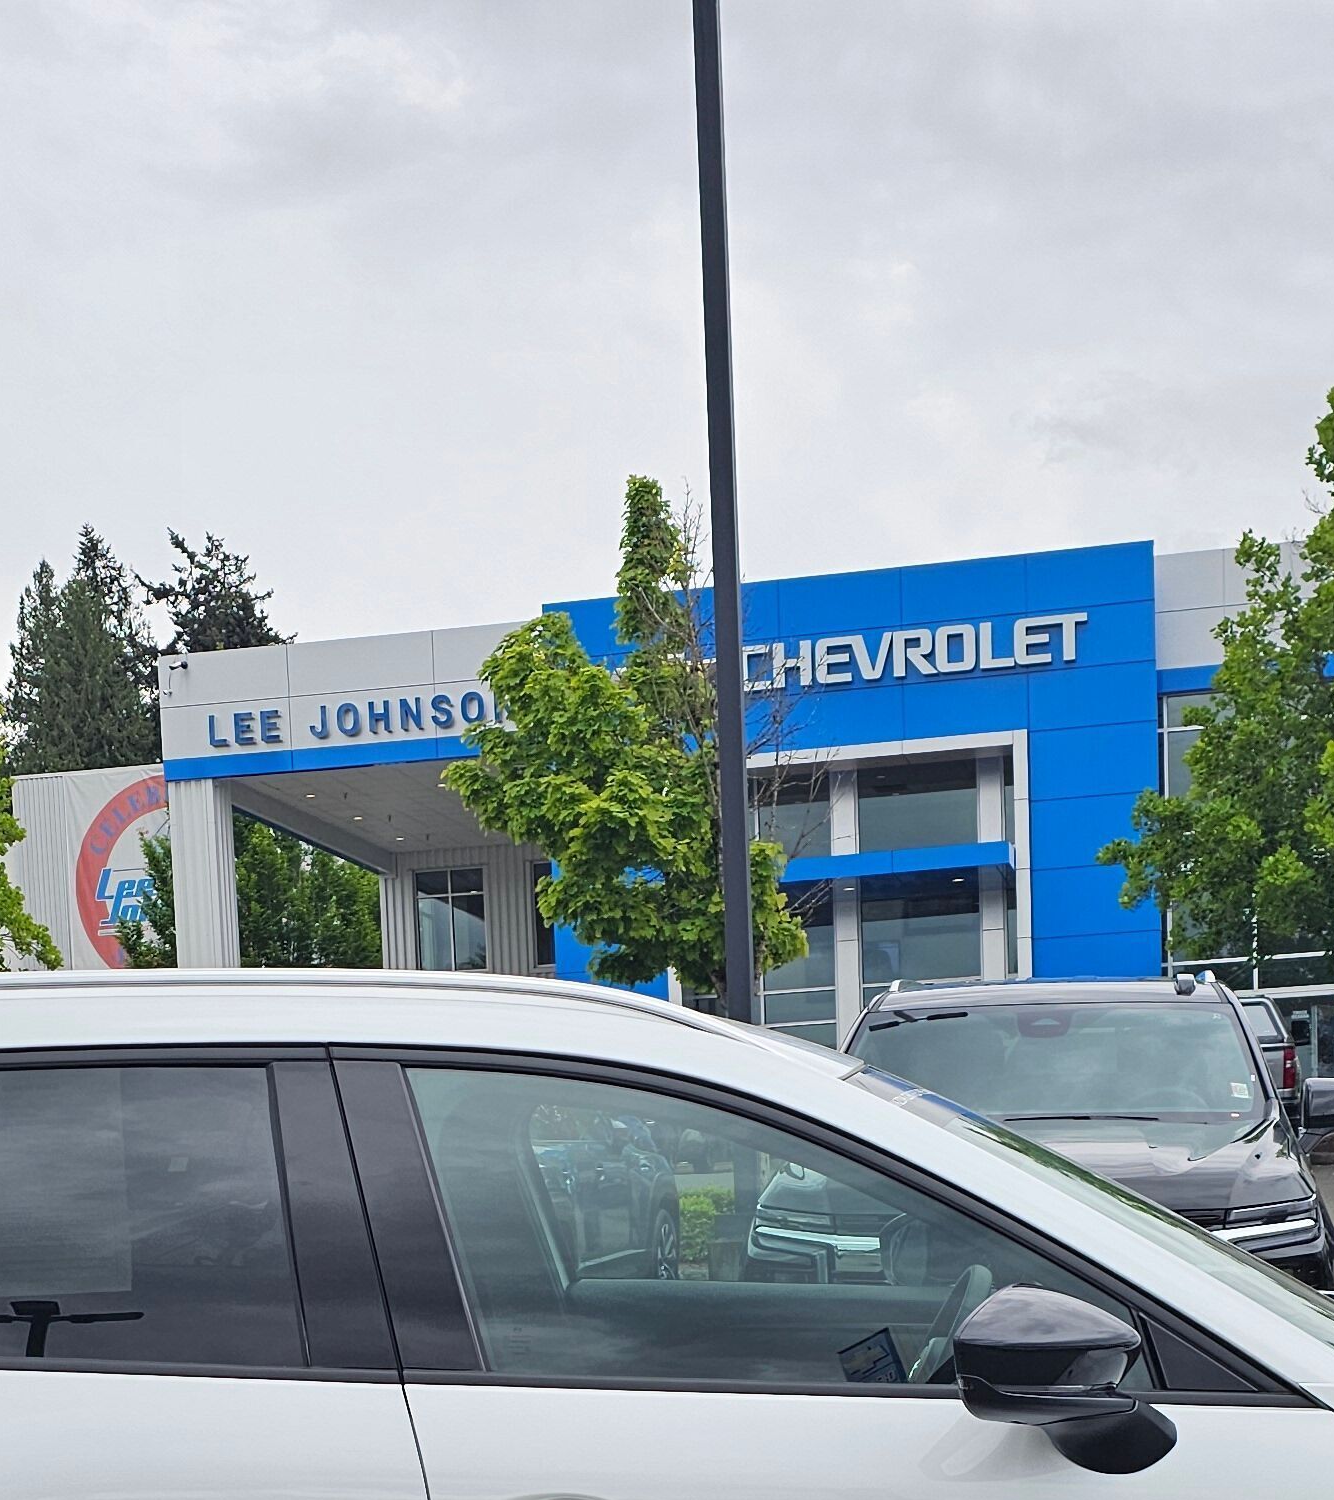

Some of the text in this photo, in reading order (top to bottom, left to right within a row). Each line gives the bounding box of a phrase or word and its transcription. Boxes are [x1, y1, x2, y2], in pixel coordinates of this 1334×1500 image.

[741, 612, 1088, 692] CHEVROLET
[208, 709, 283, 747] LEE
[90, 784, 169, 855] CELEB
